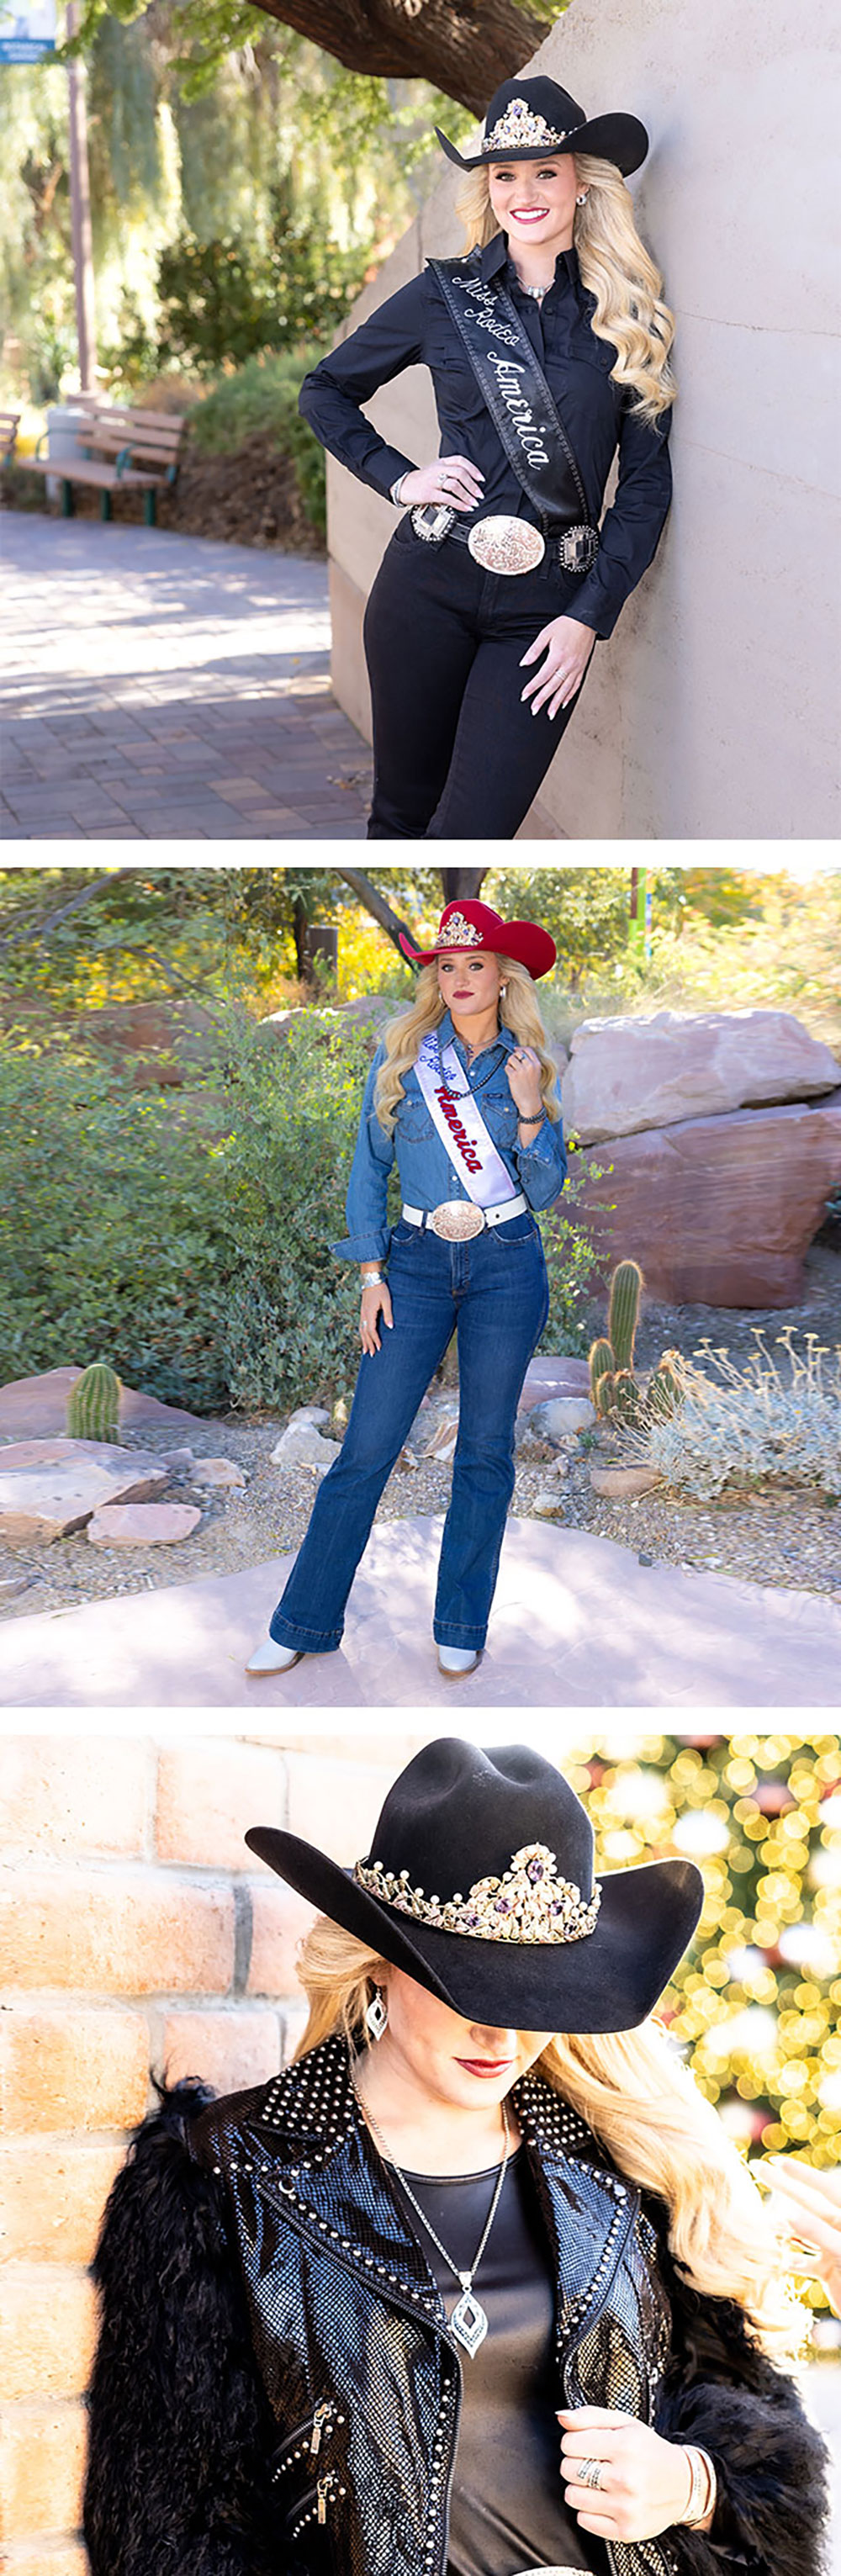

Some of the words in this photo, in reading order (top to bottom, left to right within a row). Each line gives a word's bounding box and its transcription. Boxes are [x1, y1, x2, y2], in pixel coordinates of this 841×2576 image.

[452, 276, 498, 306] Miss
[464, 307, 520, 346] Rodeo
[487, 351, 549, 470] America
[434, 1086, 483, 1174] America
